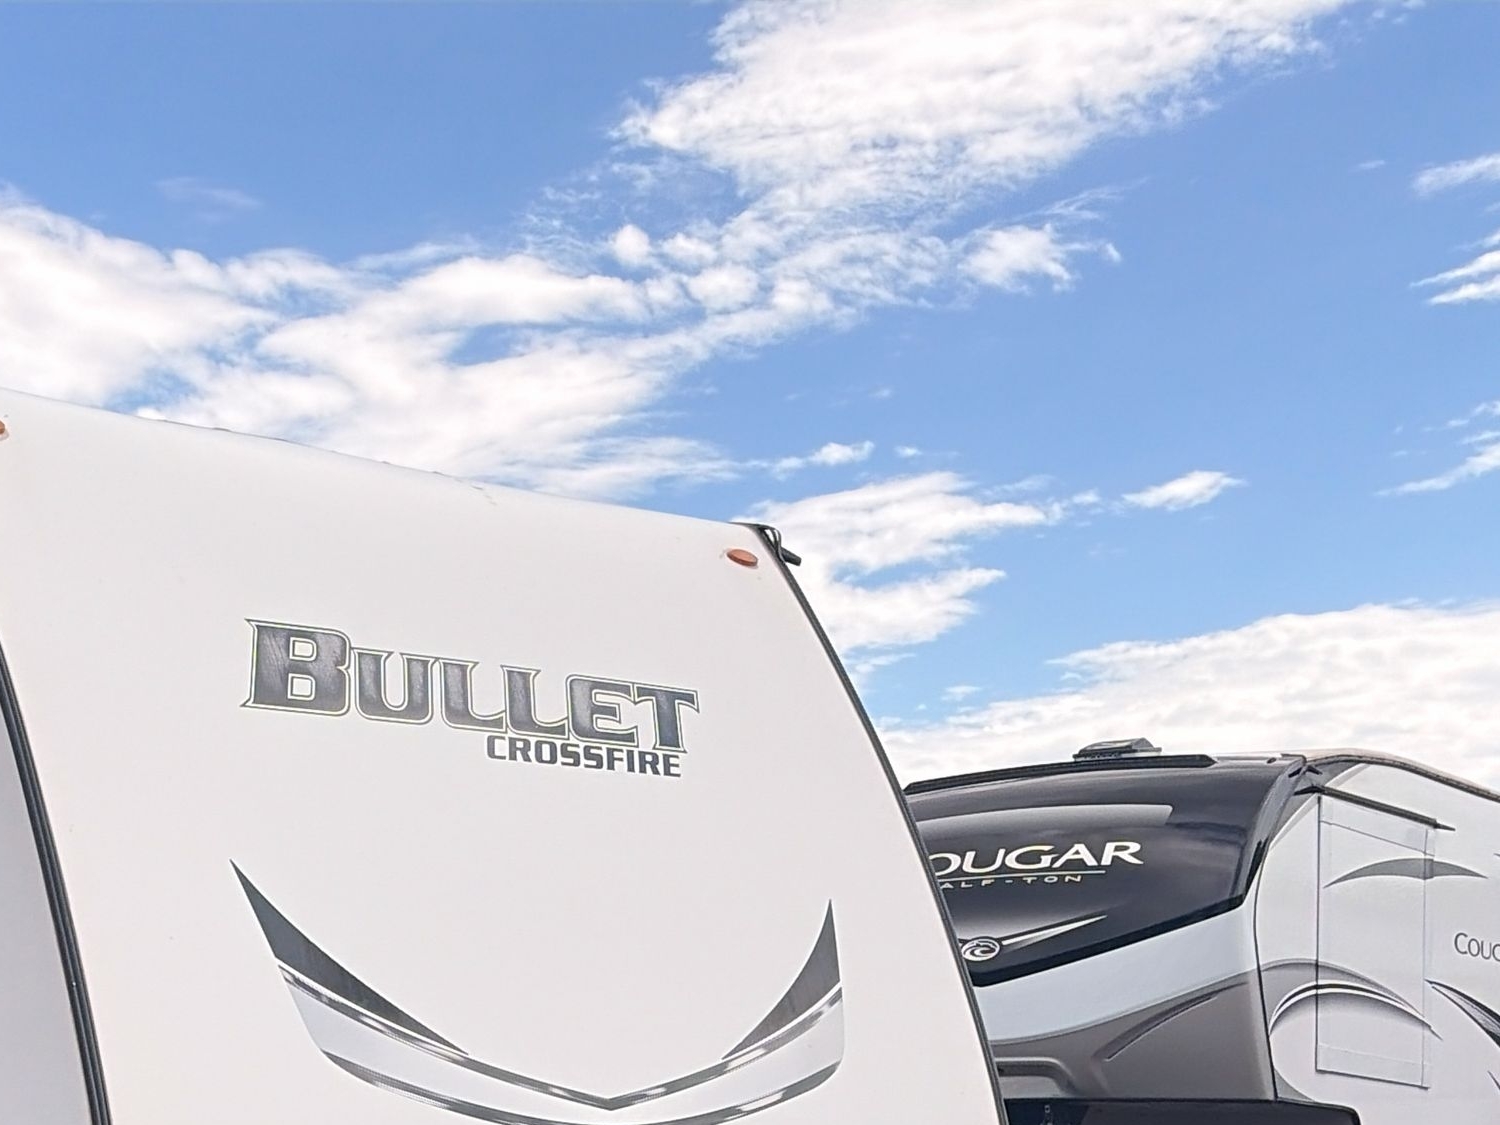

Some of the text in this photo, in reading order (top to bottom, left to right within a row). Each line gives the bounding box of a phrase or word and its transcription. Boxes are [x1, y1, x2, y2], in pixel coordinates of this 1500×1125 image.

[240, 618, 699, 754] BULLET
[486, 735, 681, 777] CROSSFIRE
[929, 841, 1144, 876] OUGAR
[940, 875, 1083, 889] ALF-TON
